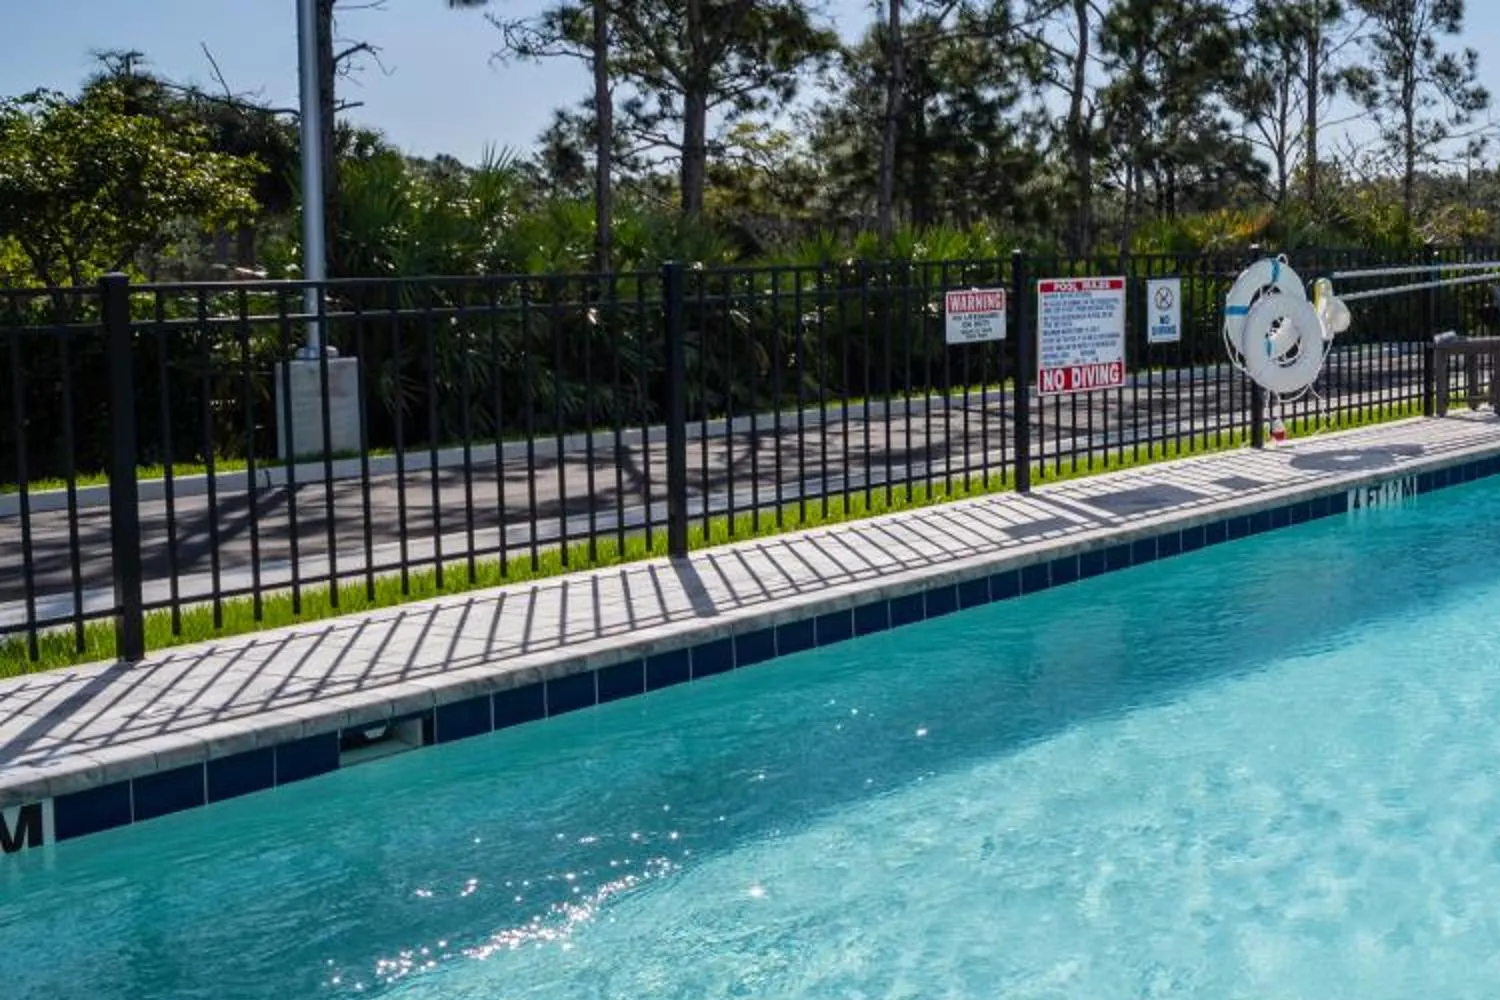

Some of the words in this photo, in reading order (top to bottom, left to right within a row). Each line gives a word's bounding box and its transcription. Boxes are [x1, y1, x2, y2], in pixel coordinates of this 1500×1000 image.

[949, 293, 1001, 311] WARNING
[1043, 368, 1065, 391] NO
[1071, 363, 1120, 388] DIVING
